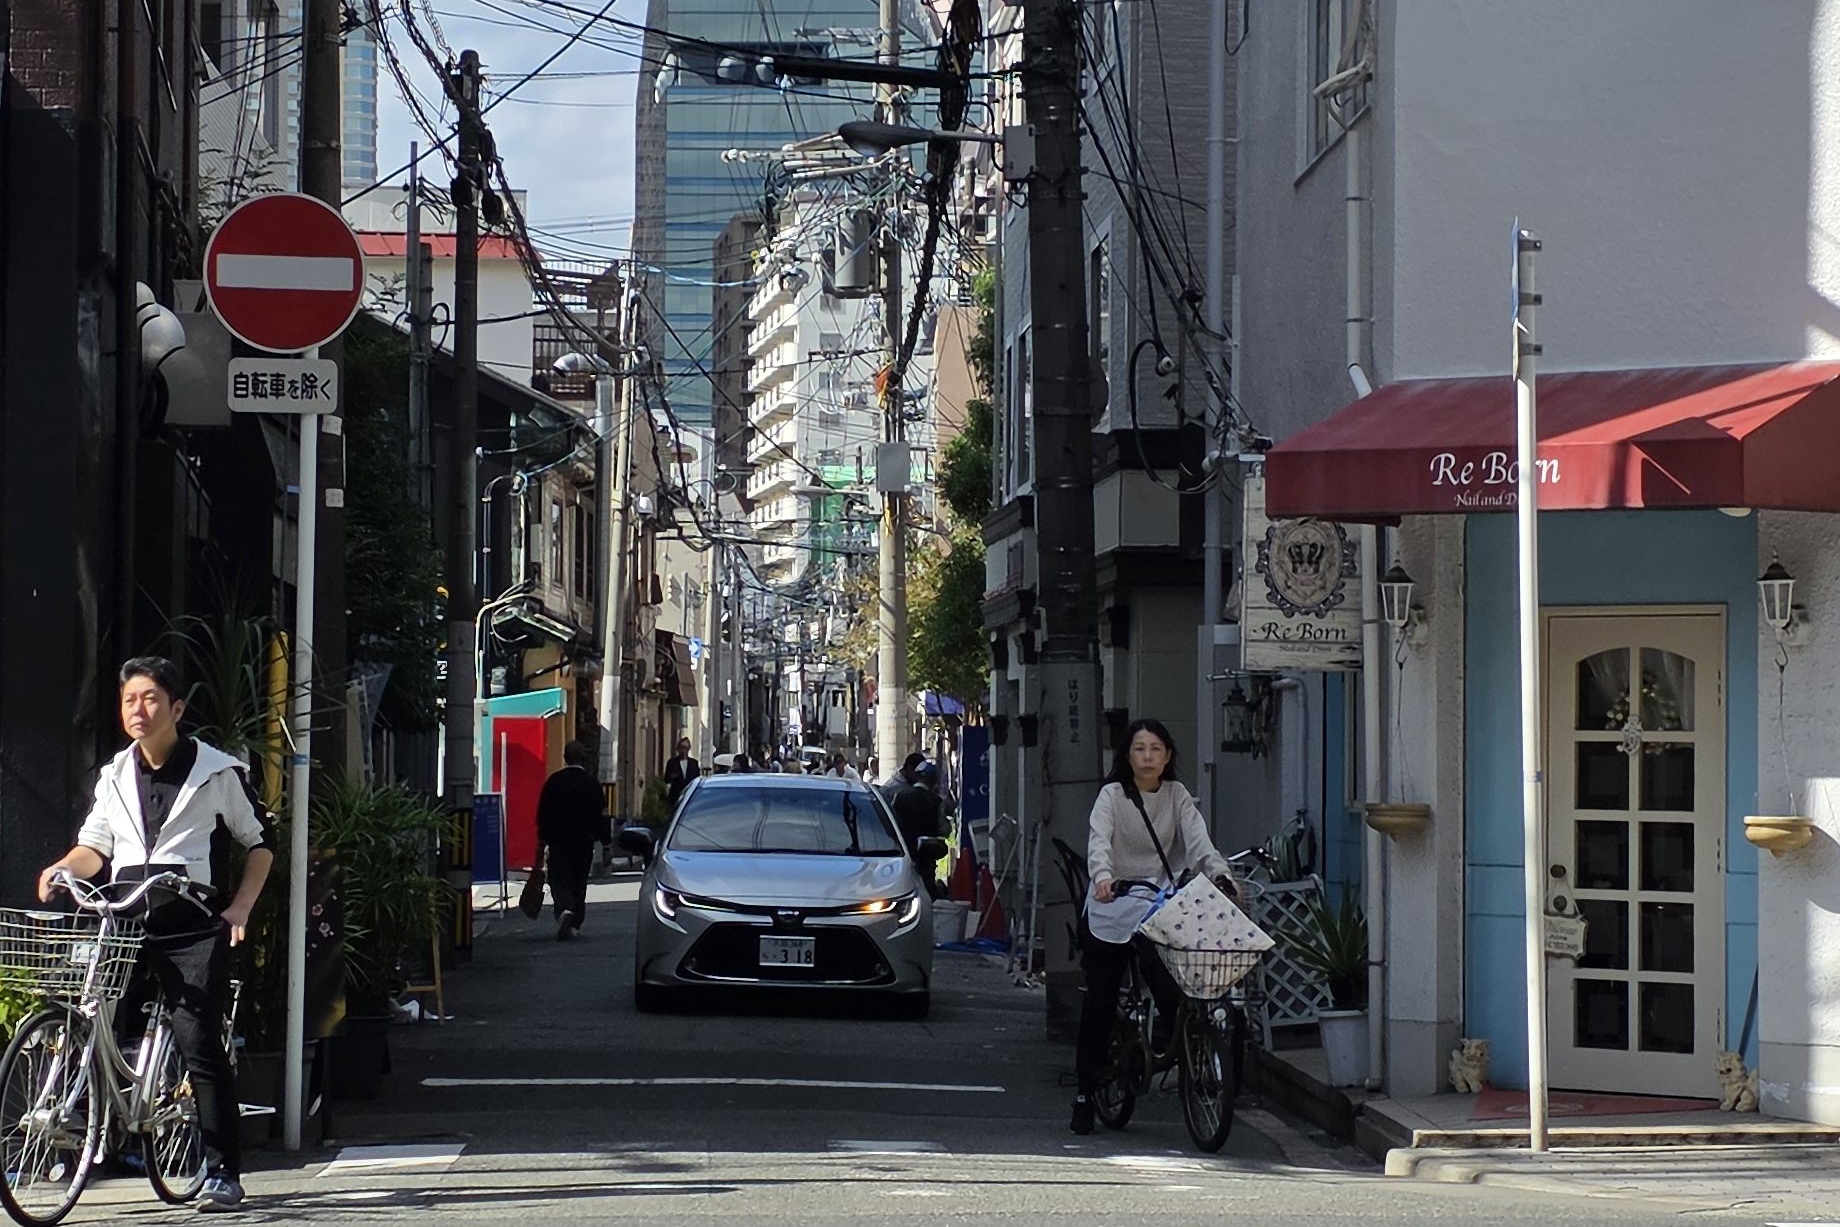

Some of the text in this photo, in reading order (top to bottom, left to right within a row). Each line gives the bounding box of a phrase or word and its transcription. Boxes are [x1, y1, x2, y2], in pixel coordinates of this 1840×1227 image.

[233, 371, 331, 401] 自転車を除く
[1430, 451, 1561, 486] Re Bon
[1296, 622, 1347, 640] Born
